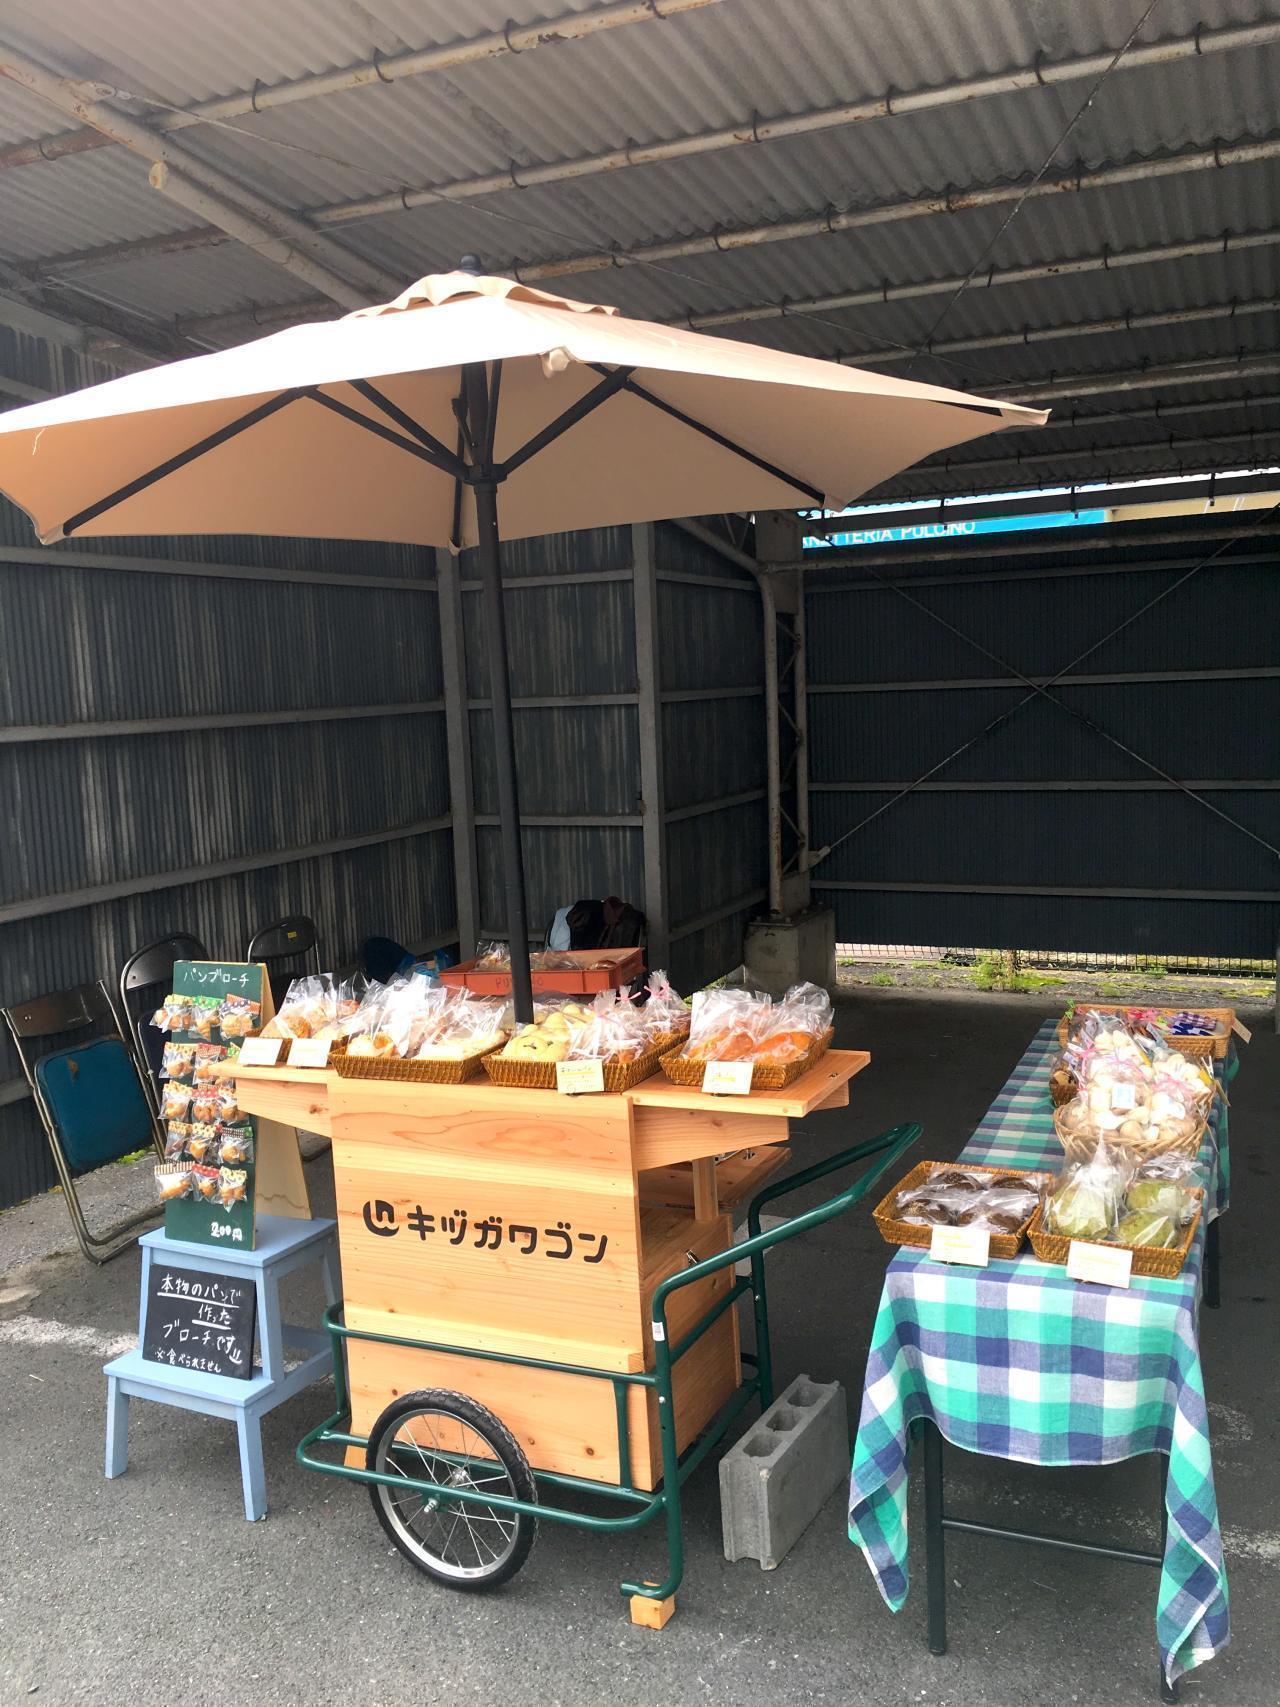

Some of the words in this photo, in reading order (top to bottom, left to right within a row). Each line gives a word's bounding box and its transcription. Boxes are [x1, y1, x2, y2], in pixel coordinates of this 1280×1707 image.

[183, 968, 250, 988] パンブローチ
[211, 1222, 242, 1242] 200円
[407, 1205, 608, 1263] キヅガワゴン
[161, 1273, 241, 1304] 本物のパンで
[198, 1303, 232, 1325] 作った
